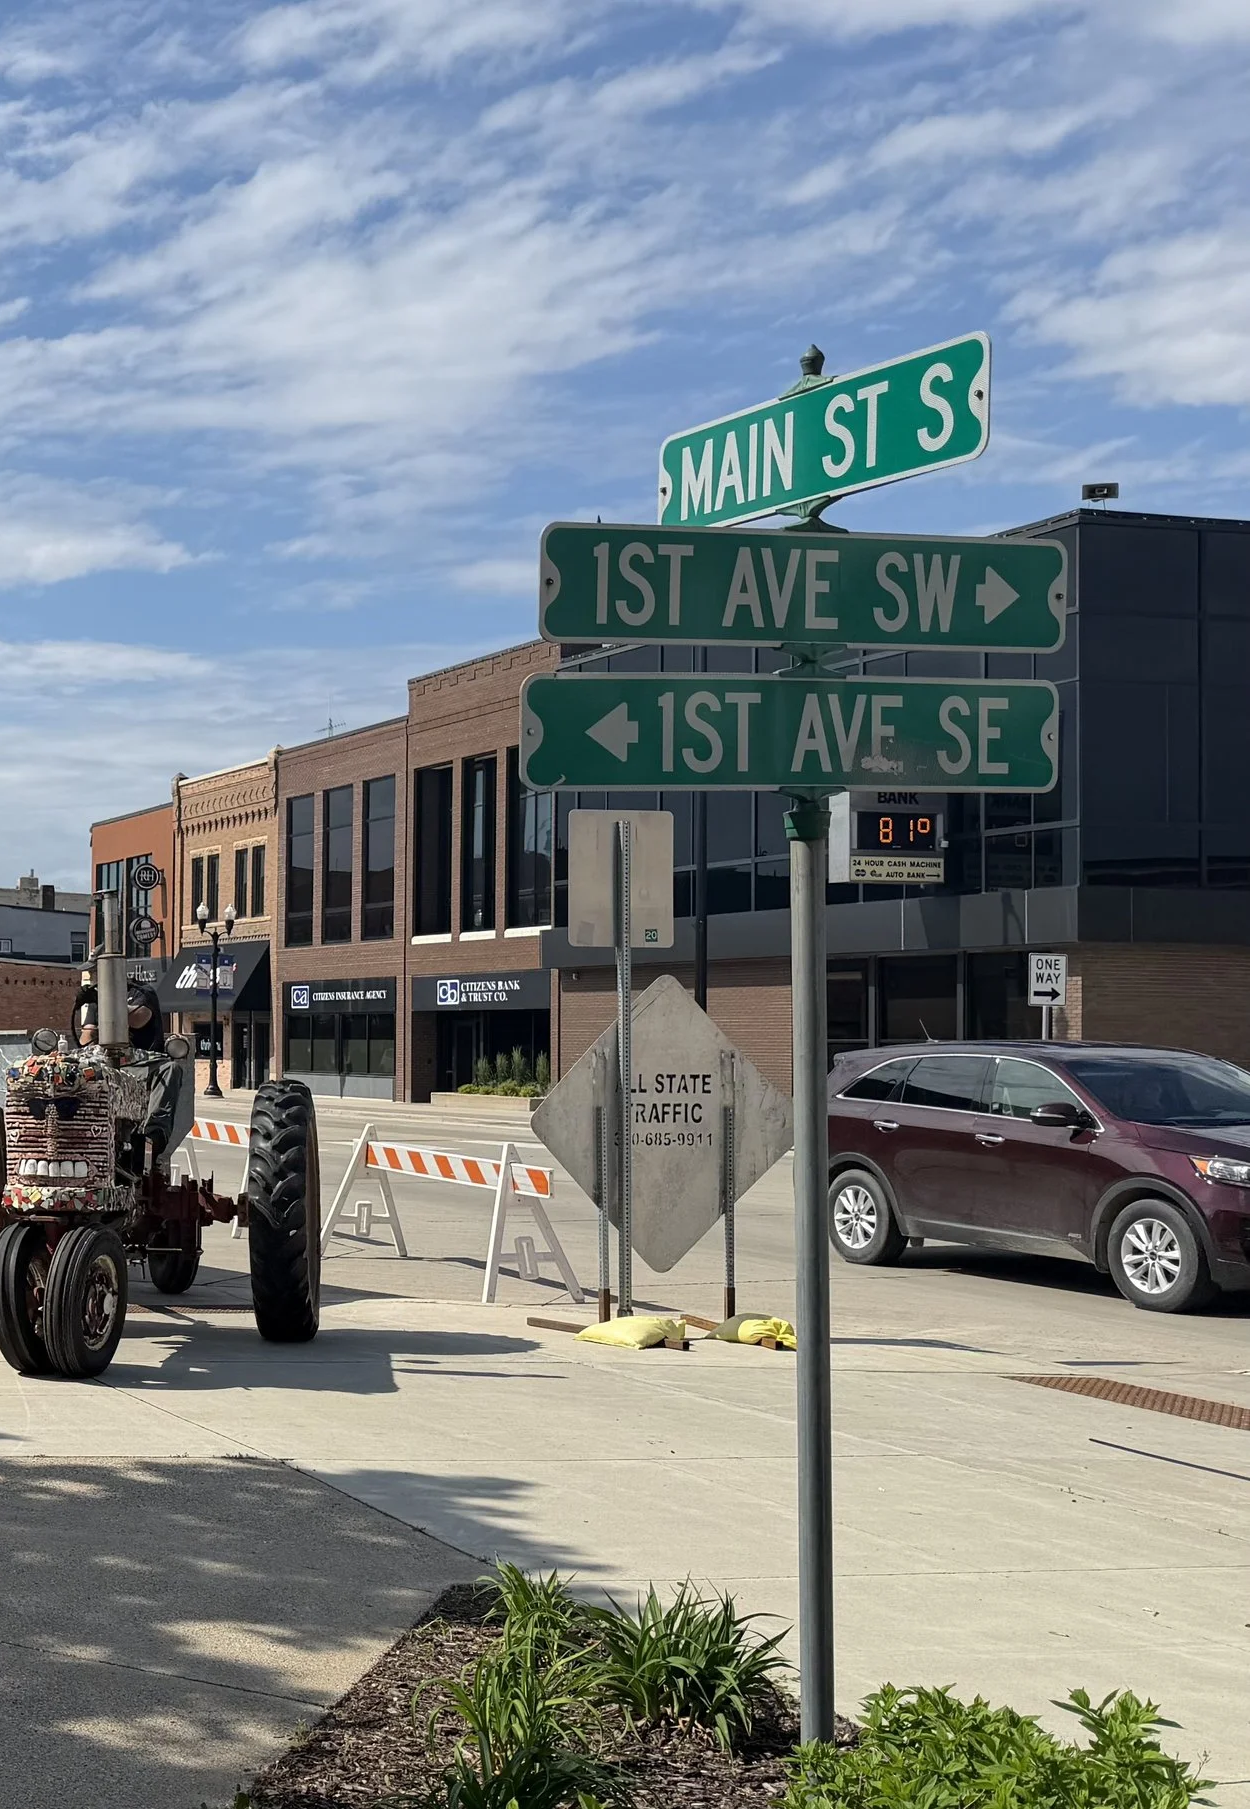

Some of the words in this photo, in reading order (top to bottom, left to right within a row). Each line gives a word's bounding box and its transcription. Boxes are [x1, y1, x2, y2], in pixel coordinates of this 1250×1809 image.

[680, 411, 794, 521] MAIN
[822, 381, 888, 478] ST
[917, 363, 954, 452] S
[593, 541, 694, 627] 1ST
[722, 547, 839, 630] AVE
[873, 551, 961, 633] SW
[657, 691, 761, 774] 1ST
[790, 693, 903, 775] AVE
[936, 695, 1009, 775] SE
[877, 792, 919, 805] BANK
[864, 859, 884, 867] HOUR
[910, 861, 941, 869] MACHINE
[645, 930, 658, 941] 20
[1036, 958, 1061, 970] ONE
[1035, 972, 1061, 984] WAY
[461, 981, 496, 992] CITIZENS
[497, 980, 521, 990] BANK
[312, 992, 335, 1001] CITIZENS
[335, 991, 364, 1000] INSURANCE
[365, 990, 387, 999] AGENCY
[461, 992, 467, 1002] &
[468, 992, 493, 1002] TRUST
[494, 991, 508, 1001] CO.
[655, 1073, 711, 1094] STATE
[631, 1103, 702, 1123] RAFFIC
[614, 1132, 712, 1146] 30-685-9911
